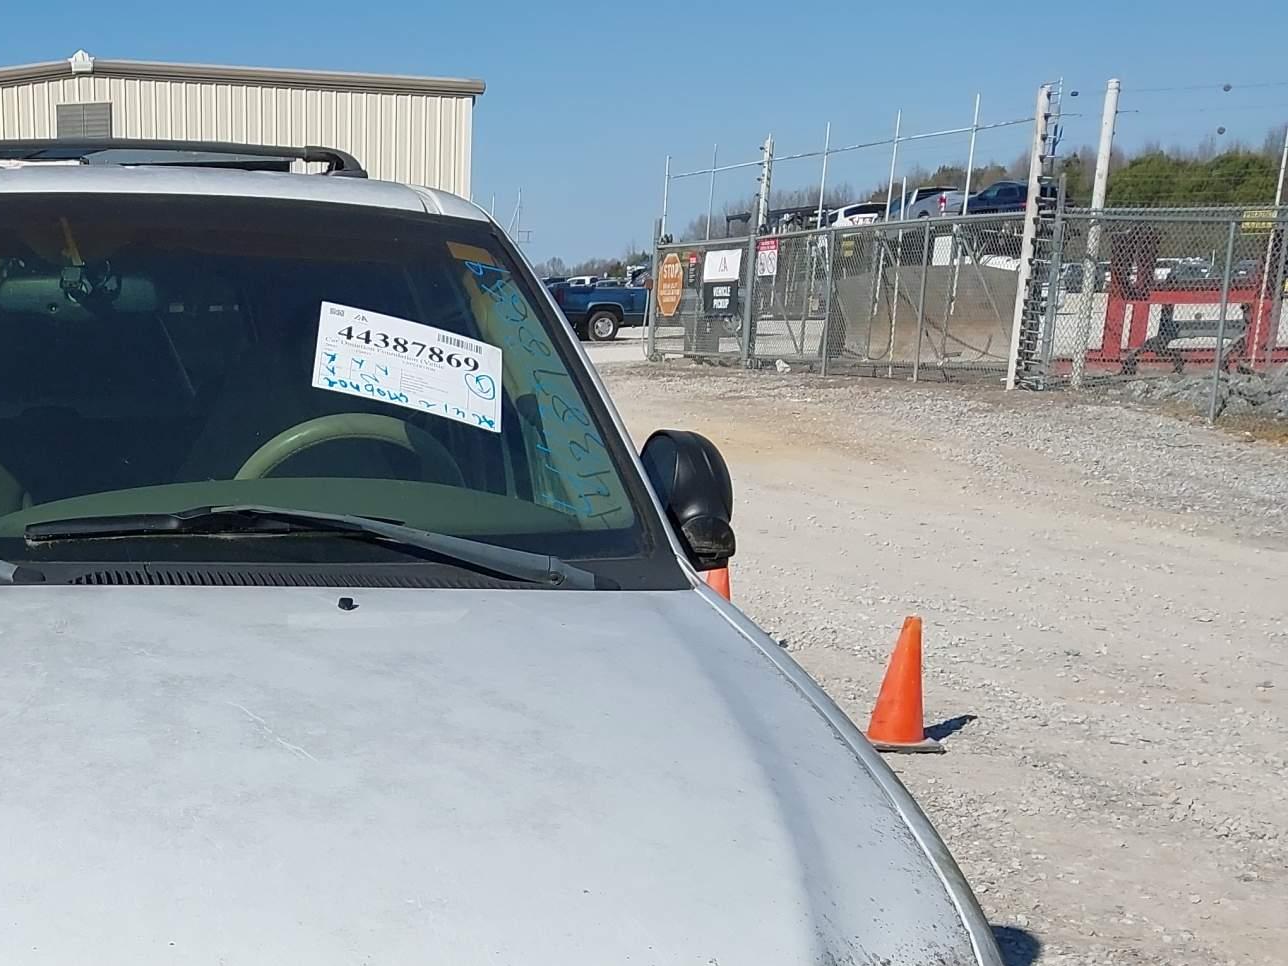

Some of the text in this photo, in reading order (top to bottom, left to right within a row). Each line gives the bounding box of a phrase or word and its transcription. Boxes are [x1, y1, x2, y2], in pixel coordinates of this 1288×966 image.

[663, 263, 679, 279] STOP
[712, 286, 731, 297] VEHICLE
[712, 298, 730, 309] PICKUP
[337, 325, 480, 372] 44387869
